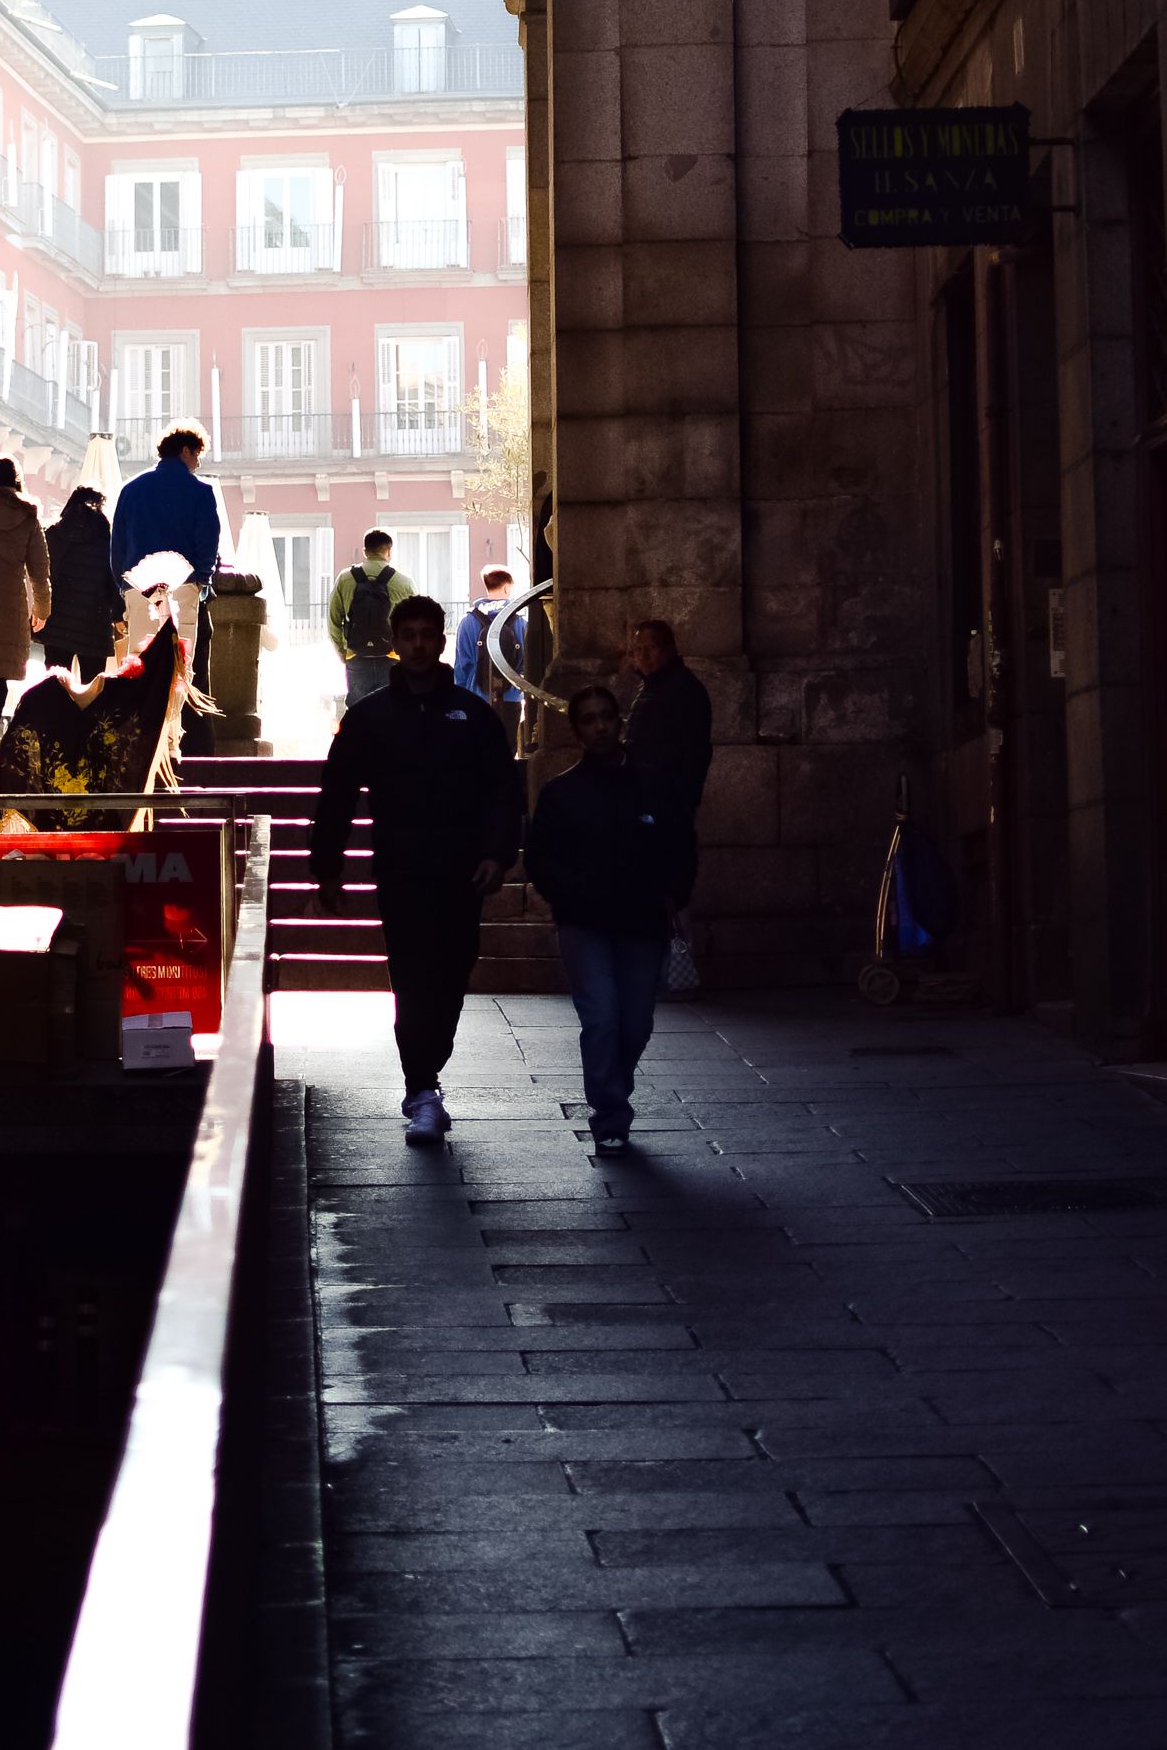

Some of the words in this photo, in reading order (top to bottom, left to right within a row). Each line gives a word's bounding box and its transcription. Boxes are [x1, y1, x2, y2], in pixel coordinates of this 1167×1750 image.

[849, 123, 915, 160] SELLOS
[919, 123, 931, 159] Y
[936, 122, 1020, 158] MONEDAS
[853, 207, 933, 227] COMPRA
[939, 206, 952, 225] Y
[961, 203, 1024, 225] VENTA
